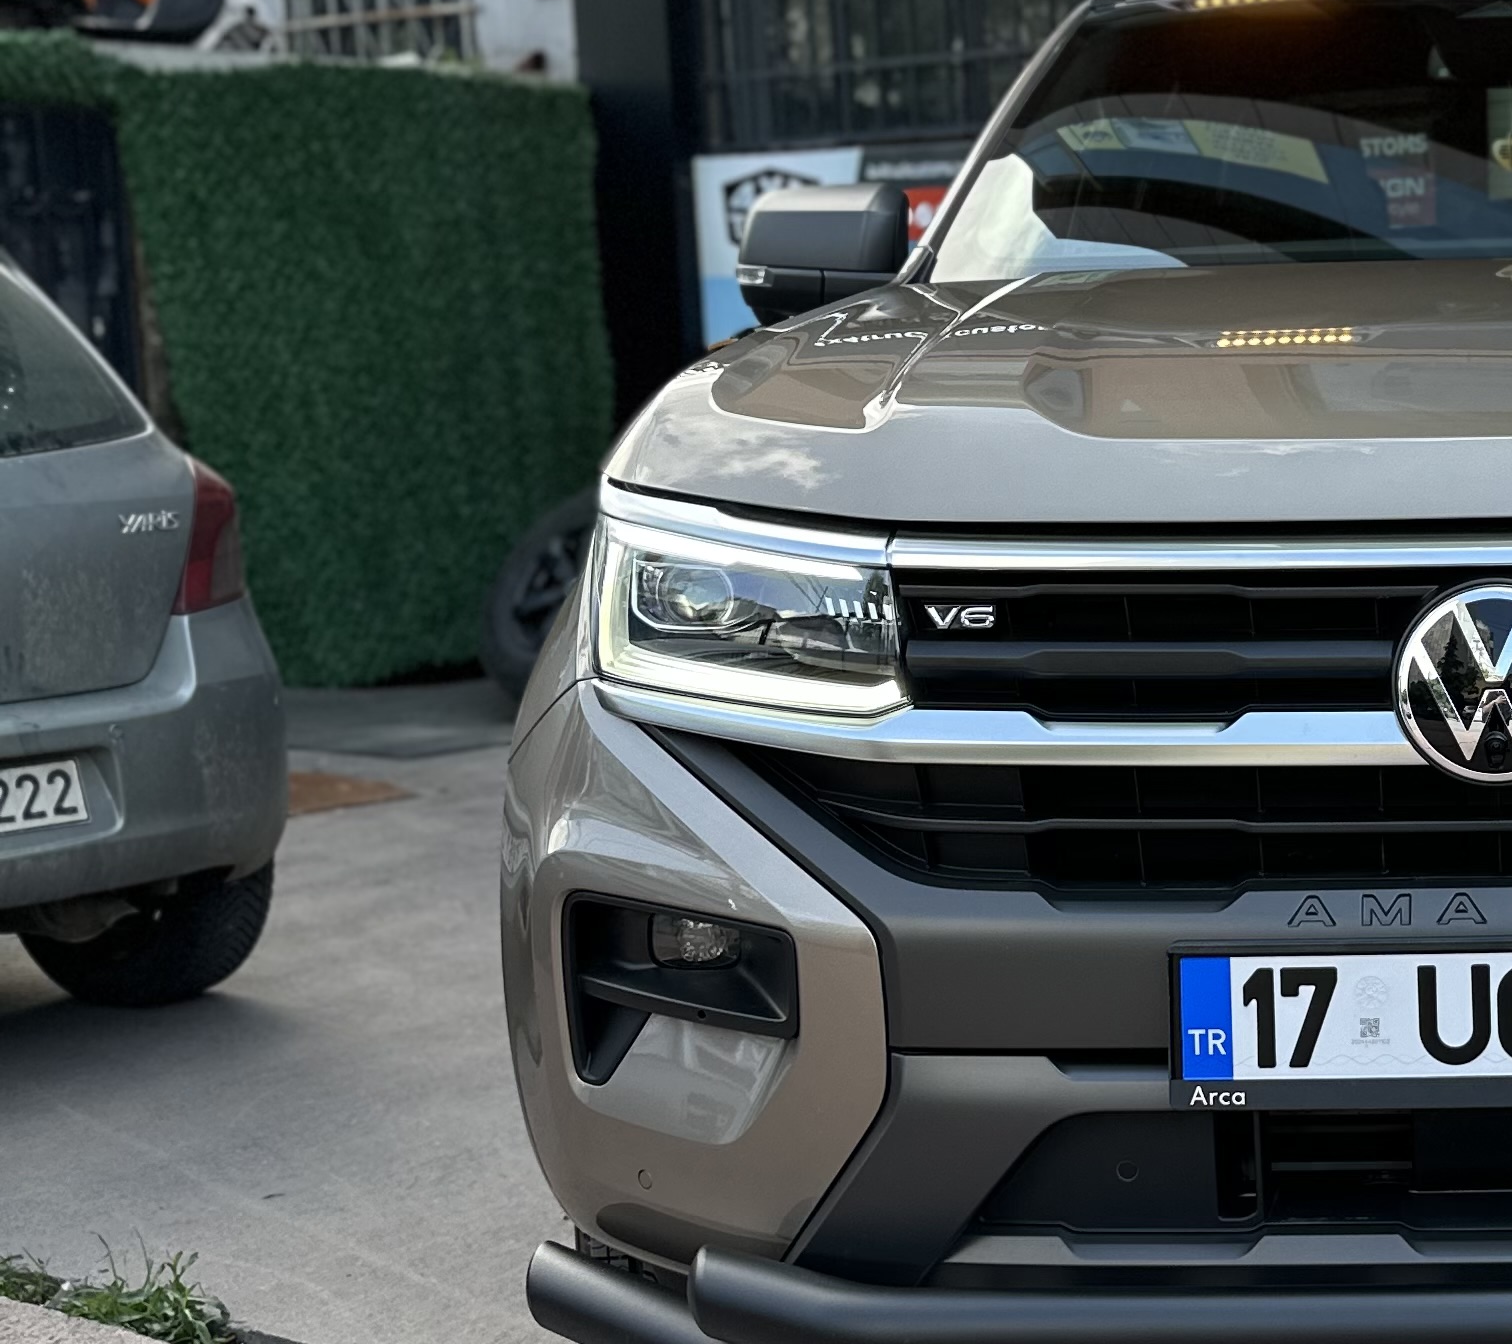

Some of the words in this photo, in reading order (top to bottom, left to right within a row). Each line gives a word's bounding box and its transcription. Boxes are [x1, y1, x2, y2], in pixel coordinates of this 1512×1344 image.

[924, 605, 995, 629] V6
[1243, 966, 1338, 1068] 17
[1187, 1028, 1227, 1055] TR
[1189, 1086, 1246, 1106] Arca
